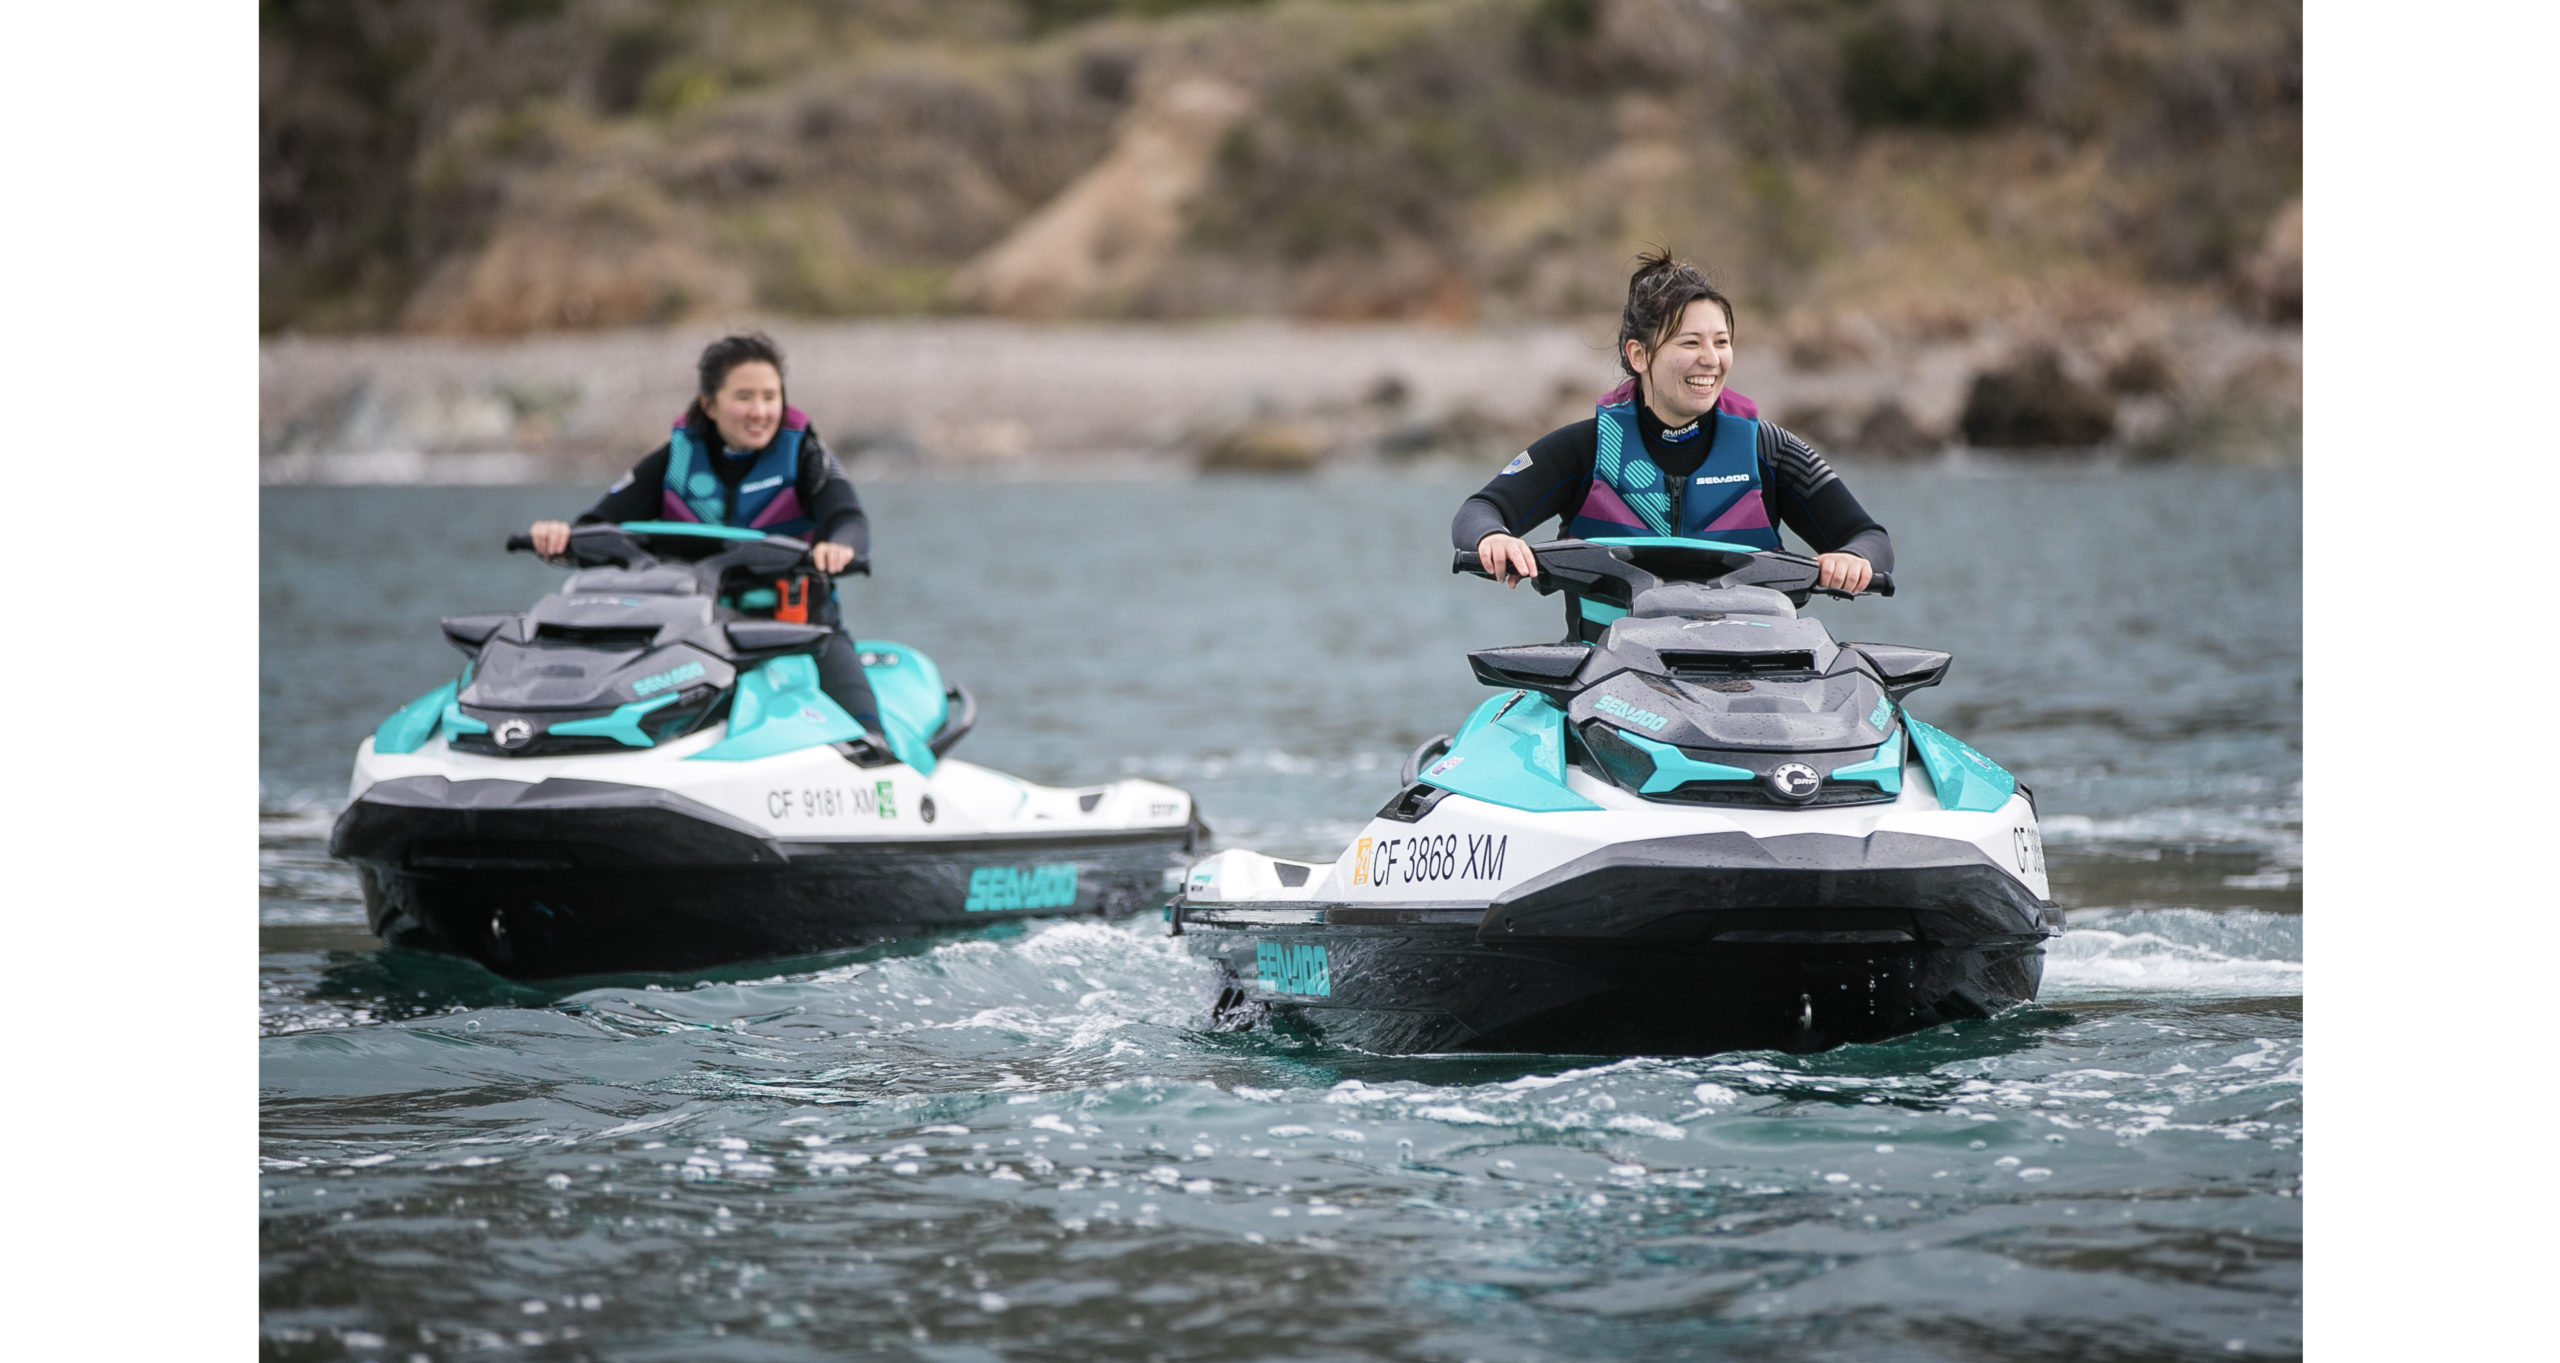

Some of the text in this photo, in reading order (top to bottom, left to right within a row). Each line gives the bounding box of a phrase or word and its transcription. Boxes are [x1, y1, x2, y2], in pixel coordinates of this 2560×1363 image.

[766, 789, 793, 820] CF
[1373, 833, 1508, 887] CF 3868 XM
[2013, 827, 2029, 874] CF
